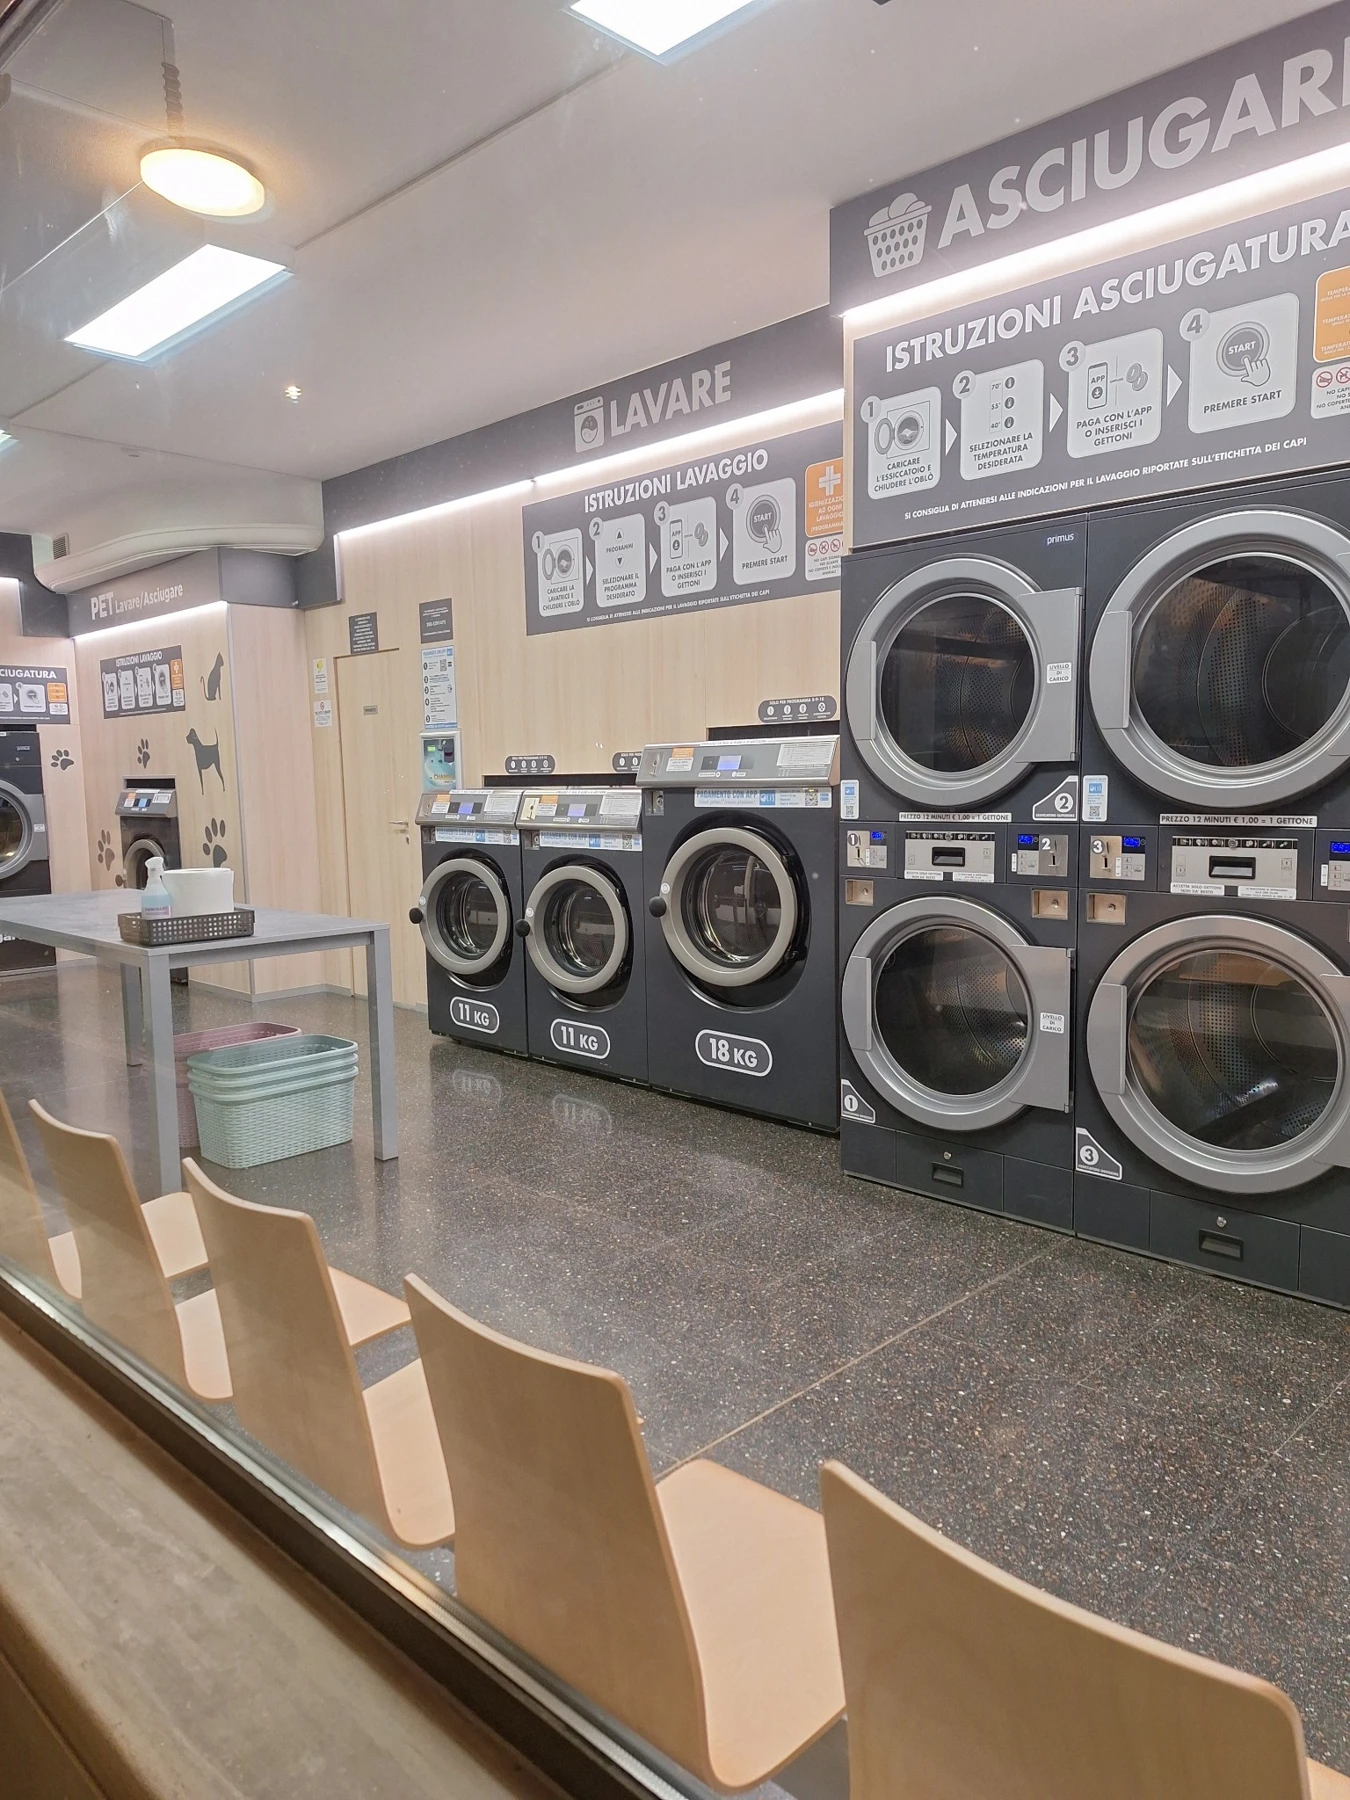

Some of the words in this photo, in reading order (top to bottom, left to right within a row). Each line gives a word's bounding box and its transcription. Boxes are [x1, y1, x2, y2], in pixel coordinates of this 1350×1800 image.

[937, 36, 1350, 249] ASCIUGAR
[886, 294, 1062, 373] ISTRUZIONI
[1073, 209, 1350, 320] ASCIUGATURA
[1186, 314, 1203, 334] 4
[1228, 341, 1256, 355] START
[1065, 346, 1079, 367] 3
[958, 375, 970, 395] 2
[1090, 374, 1106, 384] APP
[610, 360, 731, 437] LAVARE
[1203, 396, 1248, 414] PREMERE
[1251, 389, 1282, 404] START
[867, 401, 874, 418] 1
[1076, 418, 1101, 430] PAGA
[1103, 411, 1124, 423] CON
[1127, 405, 1152, 418] L'APP
[1084, 429, 1092, 438] O
[1095, 419, 1137, 436] INSERISCI
[969, 434, 1021, 453] SELEZIONARE
[1022, 431, 1033, 441] LA
[1093, 431, 1133, 447] GETTONI
[973, 443, 1028, 462] TEMPERATURA
[886, 456, 921, 471] CARICARE
[977, 454, 1023, 471] DESIDERATA
[584, 473, 671, 513] ISTRUZIONI
[676, 448, 769, 490] LAVAGGIO
[874, 478, 907, 492] CHIUDERE
[908, 471, 934, 486] L'OBLÒ
[876, 466, 926, 483] L'ESSICCATOIO
[926, 464, 932, 472] E
[904, 511, 911, 520] SI
[912, 505, 950, 518] CONSIGLIA
[951, 502, 959, 512] DI
[960, 495, 998, 509] ATTENERSI
[999, 491, 1016, 502] ALLE
[1017, 481, 1068, 498] INDICAZIONI
[1069, 478, 1086, 490] PER
[1086, 476, 1094, 485] IL
[1095, 468, 1140, 484] LAVAGGIO
[1142, 458, 1189, 476] RIPORTATE
[1191, 445, 1262, 466] SULL'ETICHETTA
[1264, 441, 1281, 453] DEI
[1282, 436, 1307, 449] CAPI
[729, 487, 740, 505] 4
[657, 505, 666, 522] 3
[753, 512, 772, 523] START
[592, 521, 600, 537] 2
[536, 535, 541, 549] 1
[1046, 532, 1075, 545] primus
[666, 563, 681, 574] PAGA
[682, 561, 695, 572] CON
[741, 558, 768, 570] PREMERE
[769, 555, 789, 565] START
[677, 570, 703, 581] INSERISCI
[546, 585, 568, 595] CARICARE
[604, 581, 638, 593] PROGRAMMA
[677, 580, 701, 589] GETTONI
[90, 591, 114, 621] PET
[115, 584, 184, 614] Lavare/Asciugare
[1049, 663, 1070, 671] LIVELLO
[696, 789, 731, 799] PAGAMENTO
[732, 789, 745, 799] CON
[745, 789, 758, 799] APP
[1059, 795, 1069, 810] 2
[930, 813, 951, 821] MINUTI
[957, 813, 971, 821] 1,00
[982, 813, 1009, 821] GETTONE
[1161, 815, 1190, 823] PREZZO
[1192, 815, 1202, 823] 12
[1203, 816, 1232, 824] MINUTI
[1233, 816, 1239, 824] €
[1241, 816, 1259, 825] 1,00
[1276, 817, 1314, 825] GETTONE
[850, 834, 855, 845] 1
[1041, 837, 1051, 850] 2
[1092, 840, 1103, 854] 3
[458, 1003, 470, 1022] 11
[474, 1010, 490, 1027] KG
[560, 1025, 575, 1047] 11
[579, 1033, 599, 1051] KG
[709, 1037, 730, 1062] 18
[733, 1047, 758, 1068] KG
[848, 1097, 853, 1109] 1
[1084, 1148, 1095, 1162] 3
